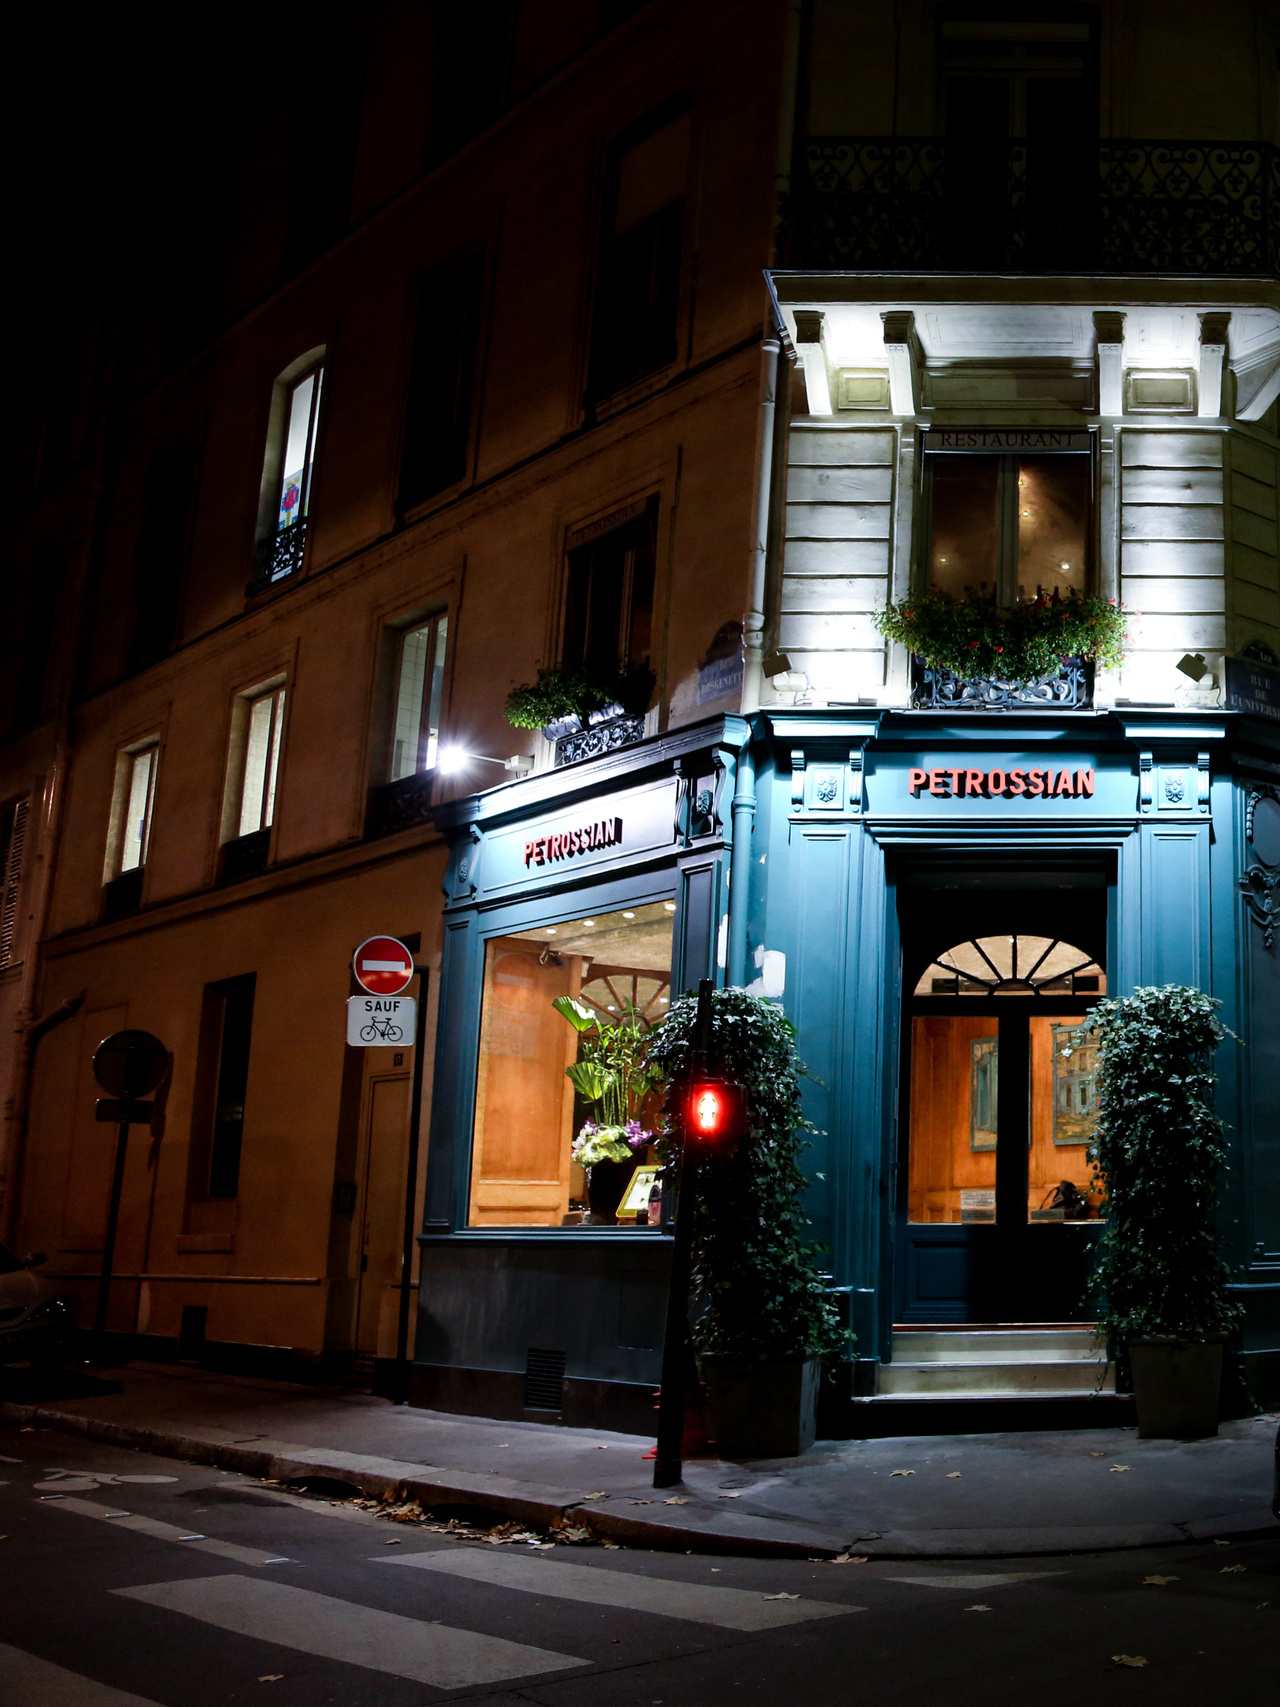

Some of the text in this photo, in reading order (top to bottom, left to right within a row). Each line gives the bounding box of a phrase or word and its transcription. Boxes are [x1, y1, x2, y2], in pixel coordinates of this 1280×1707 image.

[940, 432, 1075, 447] RESTAURANT
[1250, 674, 1272, 690] RUE
[1255, 688, 1268, 701] DE
[909, 768, 1095, 799] PETROSSIAN
[524, 817, 623, 869] PETROSSIAN
[365, 1000, 401, 1012] SAUF
